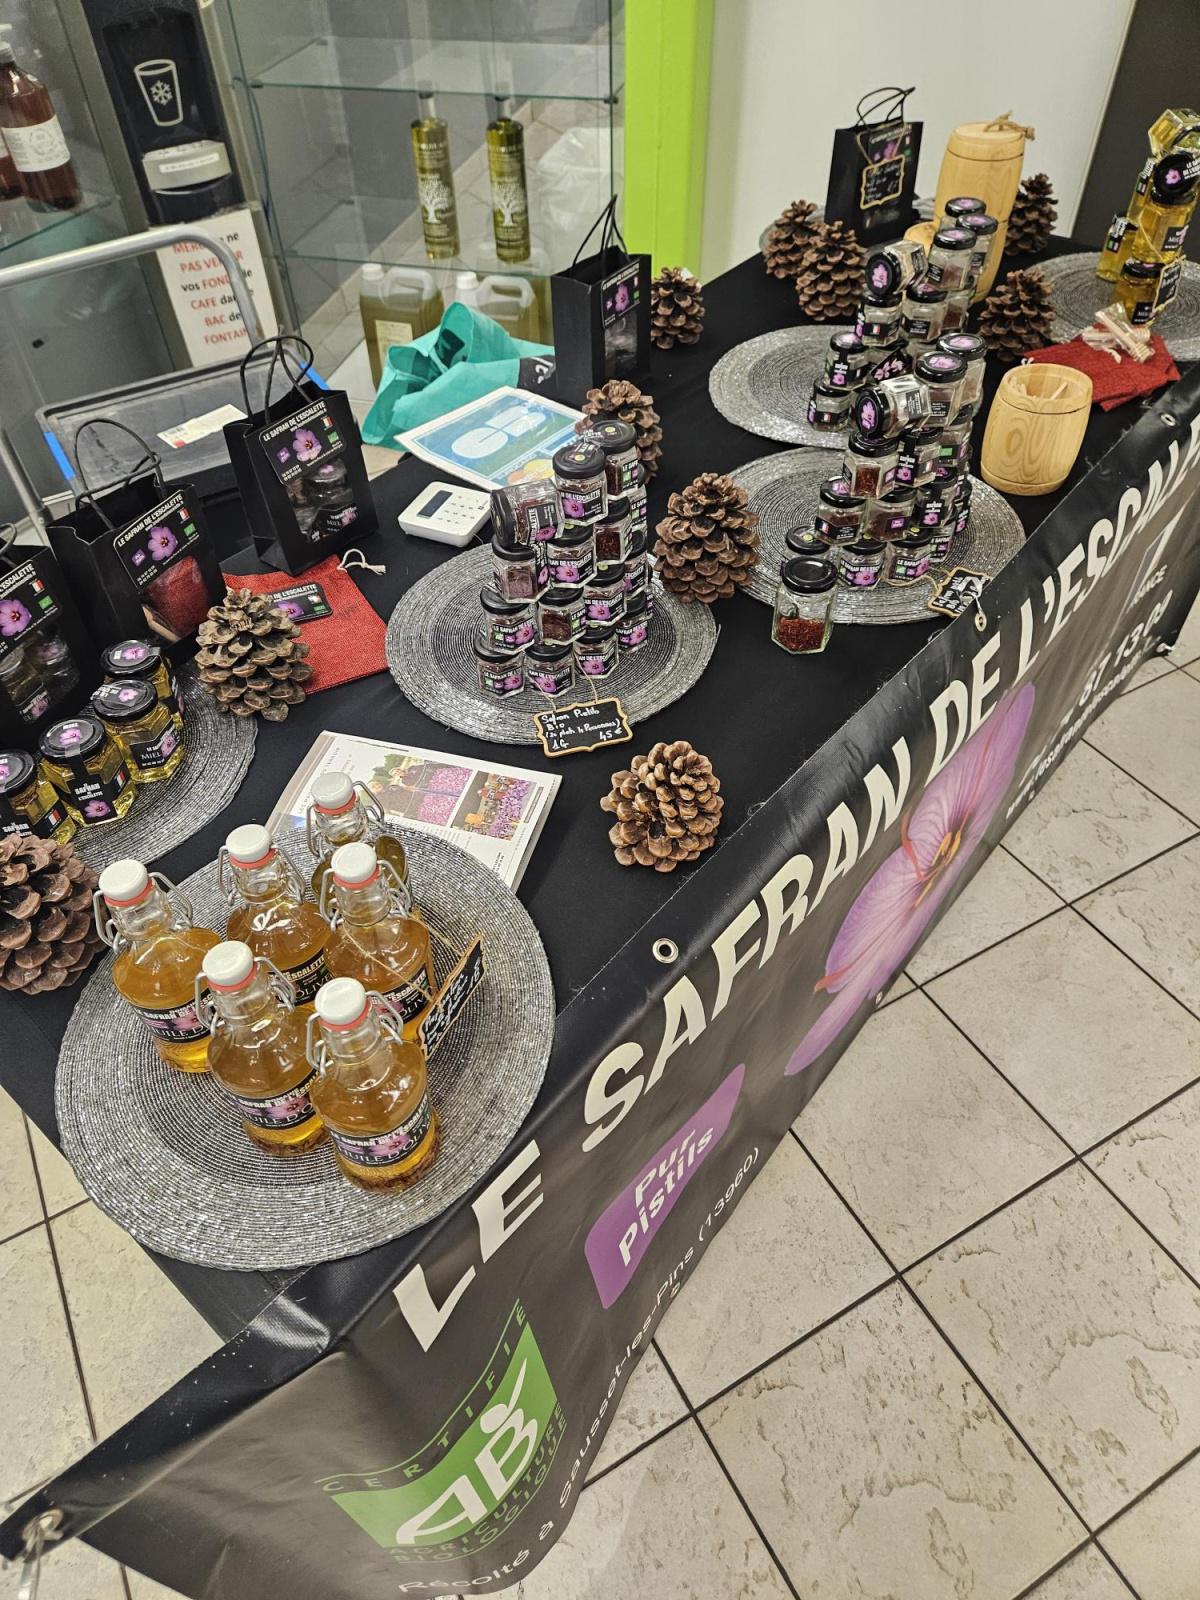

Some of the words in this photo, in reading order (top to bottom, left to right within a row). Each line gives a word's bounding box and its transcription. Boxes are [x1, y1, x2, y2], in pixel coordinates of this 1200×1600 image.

[180, 261, 202, 272] PAS
[270, 422, 290, 439] SAFRAN
[288, 417, 297, 427] DE
[295, 400, 326, 422] L'ESCALETTE
[117, 537, 126, 547] LE
[124, 523, 145, 541] SAFRAN
[143, 516, 152, 527] DE
[151, 493, 183, 520] L'ESCALETTE
[392, 1139, 544, 1352] LE
[581, 736, 911, 1153] SAFRAN
[925, 631, 1001, 787] DE
[619, 1127, 713, 1267] Pistils
[635, 1129, 696, 1208] Pur
[398, 1548, 531, 1593] Récolté
[538, 1520, 555, 1541] à
[698, 1147, 760, 1242] (13960)
[395, 1402, 539, 1545] AB
